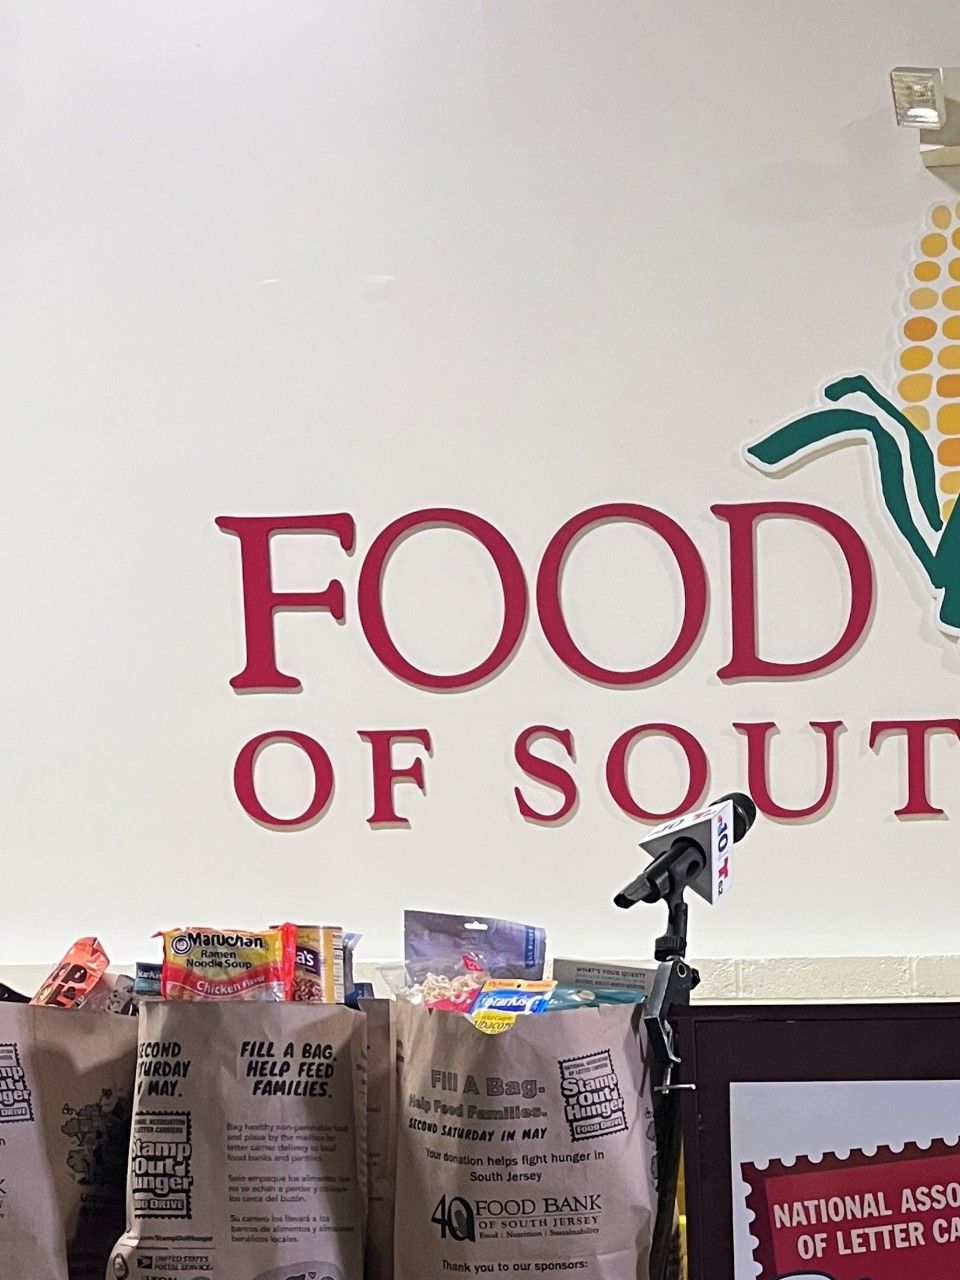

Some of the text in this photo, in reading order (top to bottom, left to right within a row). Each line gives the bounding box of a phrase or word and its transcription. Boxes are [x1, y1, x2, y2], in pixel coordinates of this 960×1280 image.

[215, 501, 874, 693] FOOD
[232, 728, 433, 832] OF
[188, 932, 264, 948] Maruchan
[201, 950, 236, 958] Ramen
[187, 959, 252, 969] Noodle Soup
[196, 975, 265, 995] Chicken Flavor
[240, 1042, 337, 1061] FILL A BAG.
[246, 1061, 335, 1078] HELP FEED
[253, 1080, 332, 1098] FAMILIES.
[431, 1069, 546, 1099] Fill A Bag.
[409, 1118, 548, 1142] SECOND SATURDAY IN MAY
[470, 1171, 542, 1182] South Jersey
[474, 1194, 602, 1216] FOOD BANK
[773, 1191, 893, 1229] NATIONAL
[478, 1216, 599, 1230] OF SOUTH JERSEY
[797, 1234, 828, 1260] OF
[837, 1221, 925, 1257] LETTER
[442, 1260, 588, 1274] Thank you to our sponsors:
